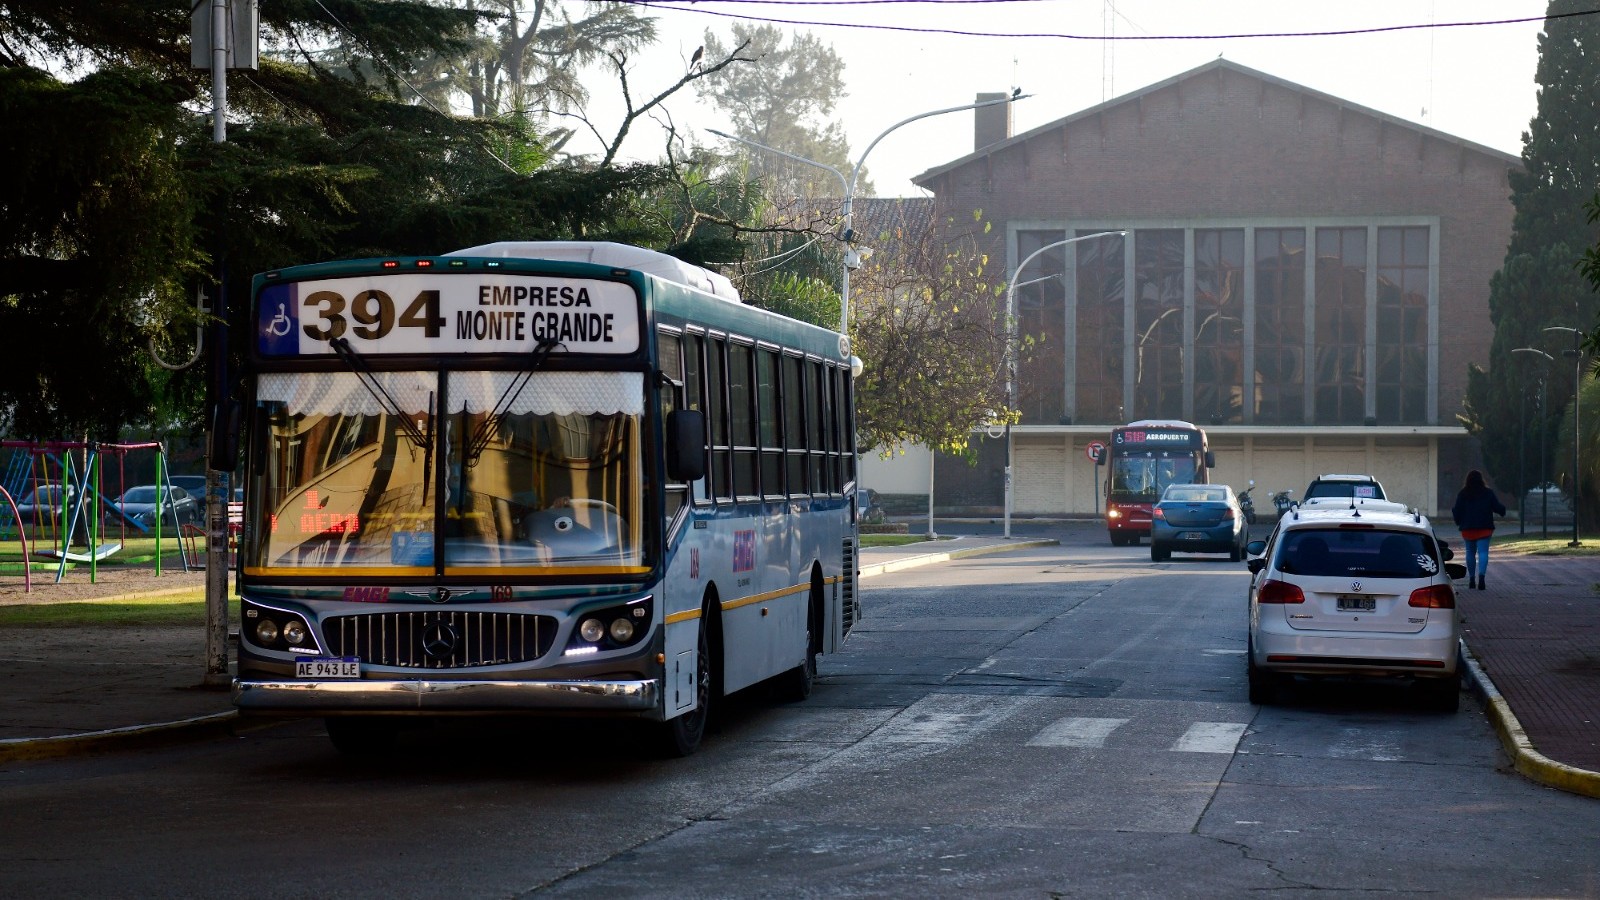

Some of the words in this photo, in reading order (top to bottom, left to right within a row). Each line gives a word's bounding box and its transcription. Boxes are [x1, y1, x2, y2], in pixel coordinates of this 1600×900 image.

[479, 286, 592, 308] EMPRESA
[303, 289, 446, 340] 394
[456, 310, 525, 341] MONTE
[531, 312, 614, 342] GRANDE
[1146, 433, 1189, 441] AEROPUERTO
[301, 514, 360, 533] AERO
[491, 586, 513, 603] 169
[298, 663, 313, 676] AE
[317, 663, 339, 676] 943
[342, 663, 357, 676] LE
